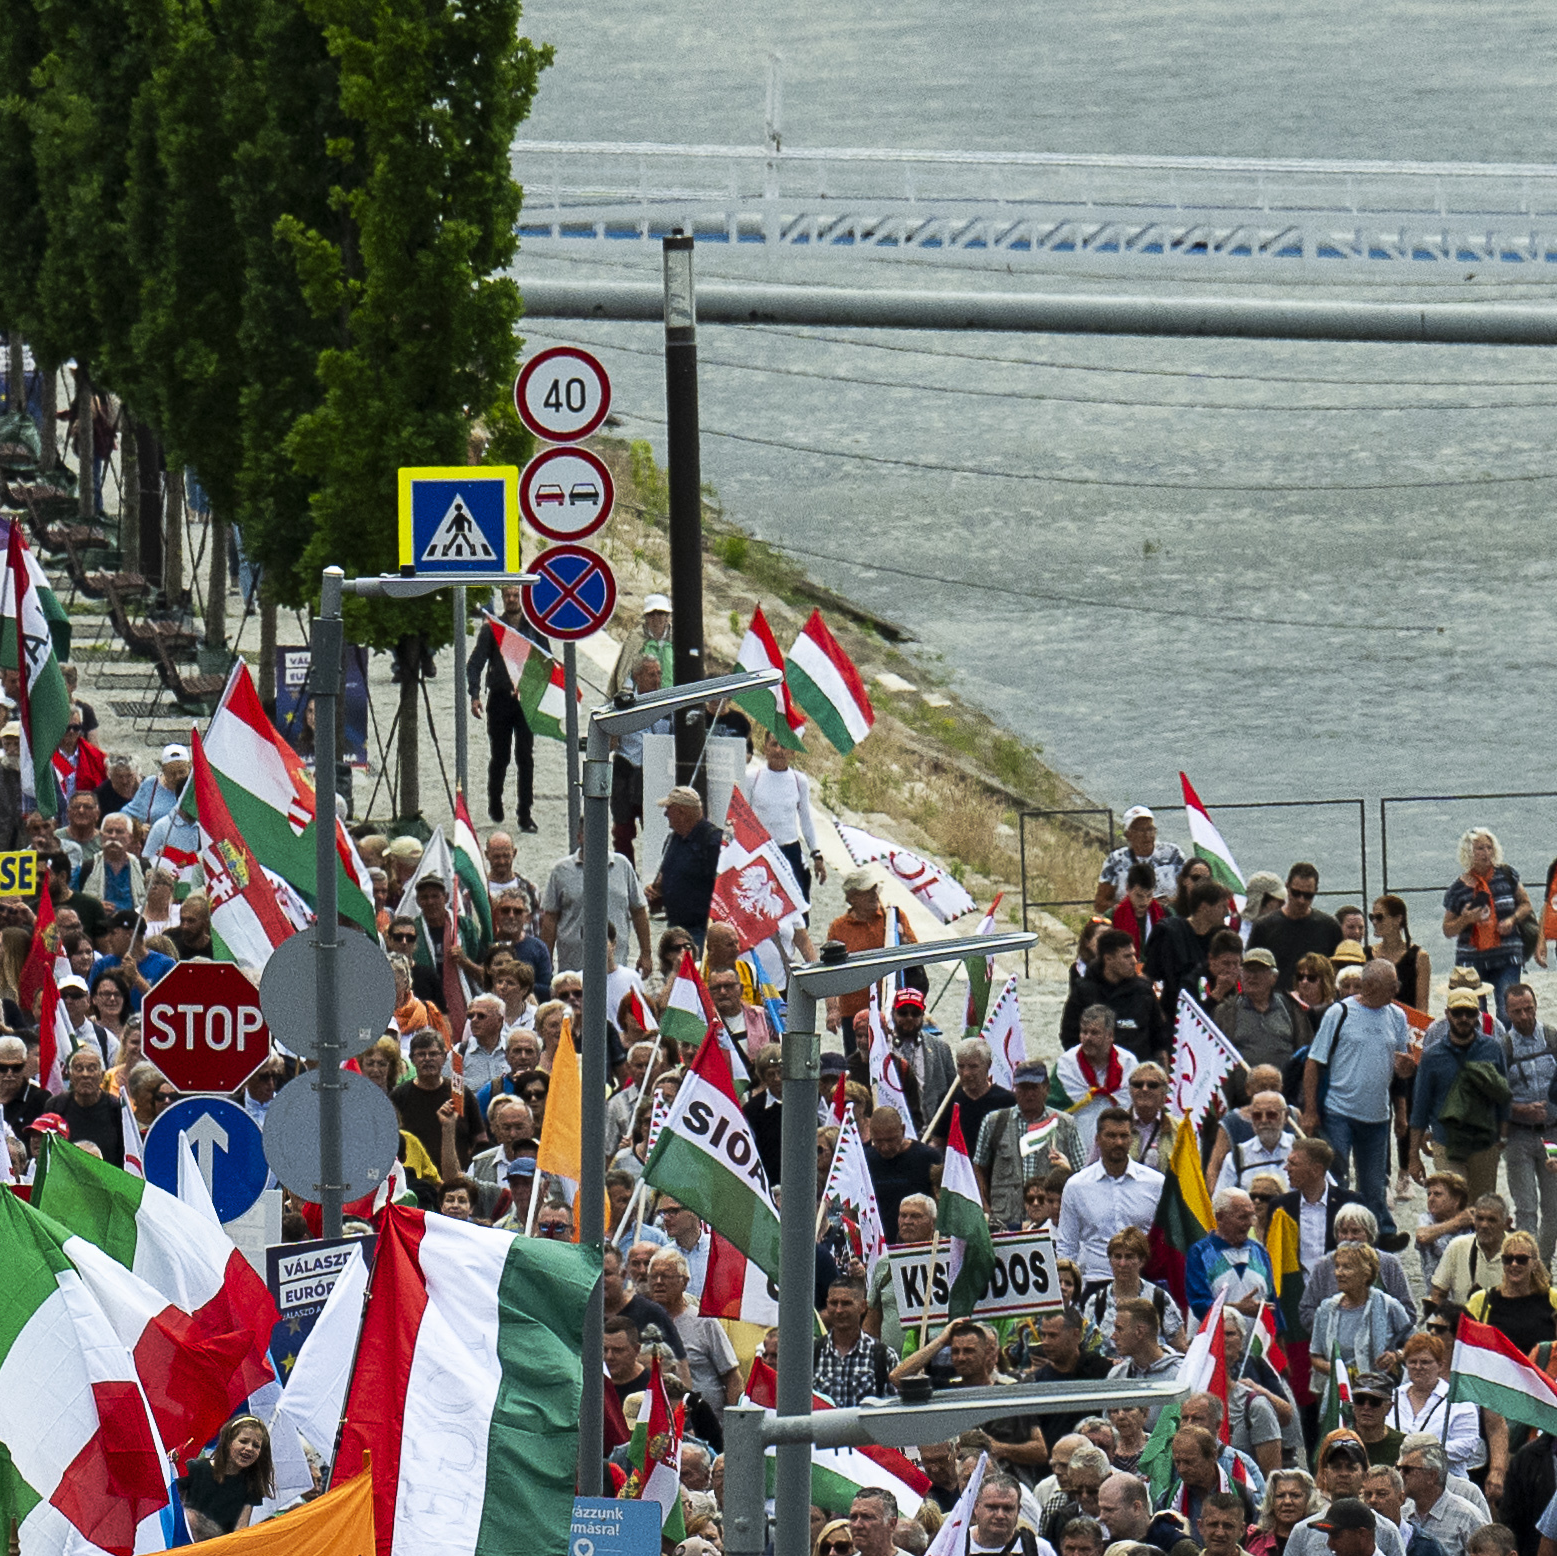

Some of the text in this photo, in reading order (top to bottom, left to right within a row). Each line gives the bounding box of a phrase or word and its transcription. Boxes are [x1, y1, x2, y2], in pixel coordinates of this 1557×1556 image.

[543, 377, 586, 413] 40
[149, 1003, 263, 1052] STOP
[900, 1250, 1050, 1309] KISDOS
